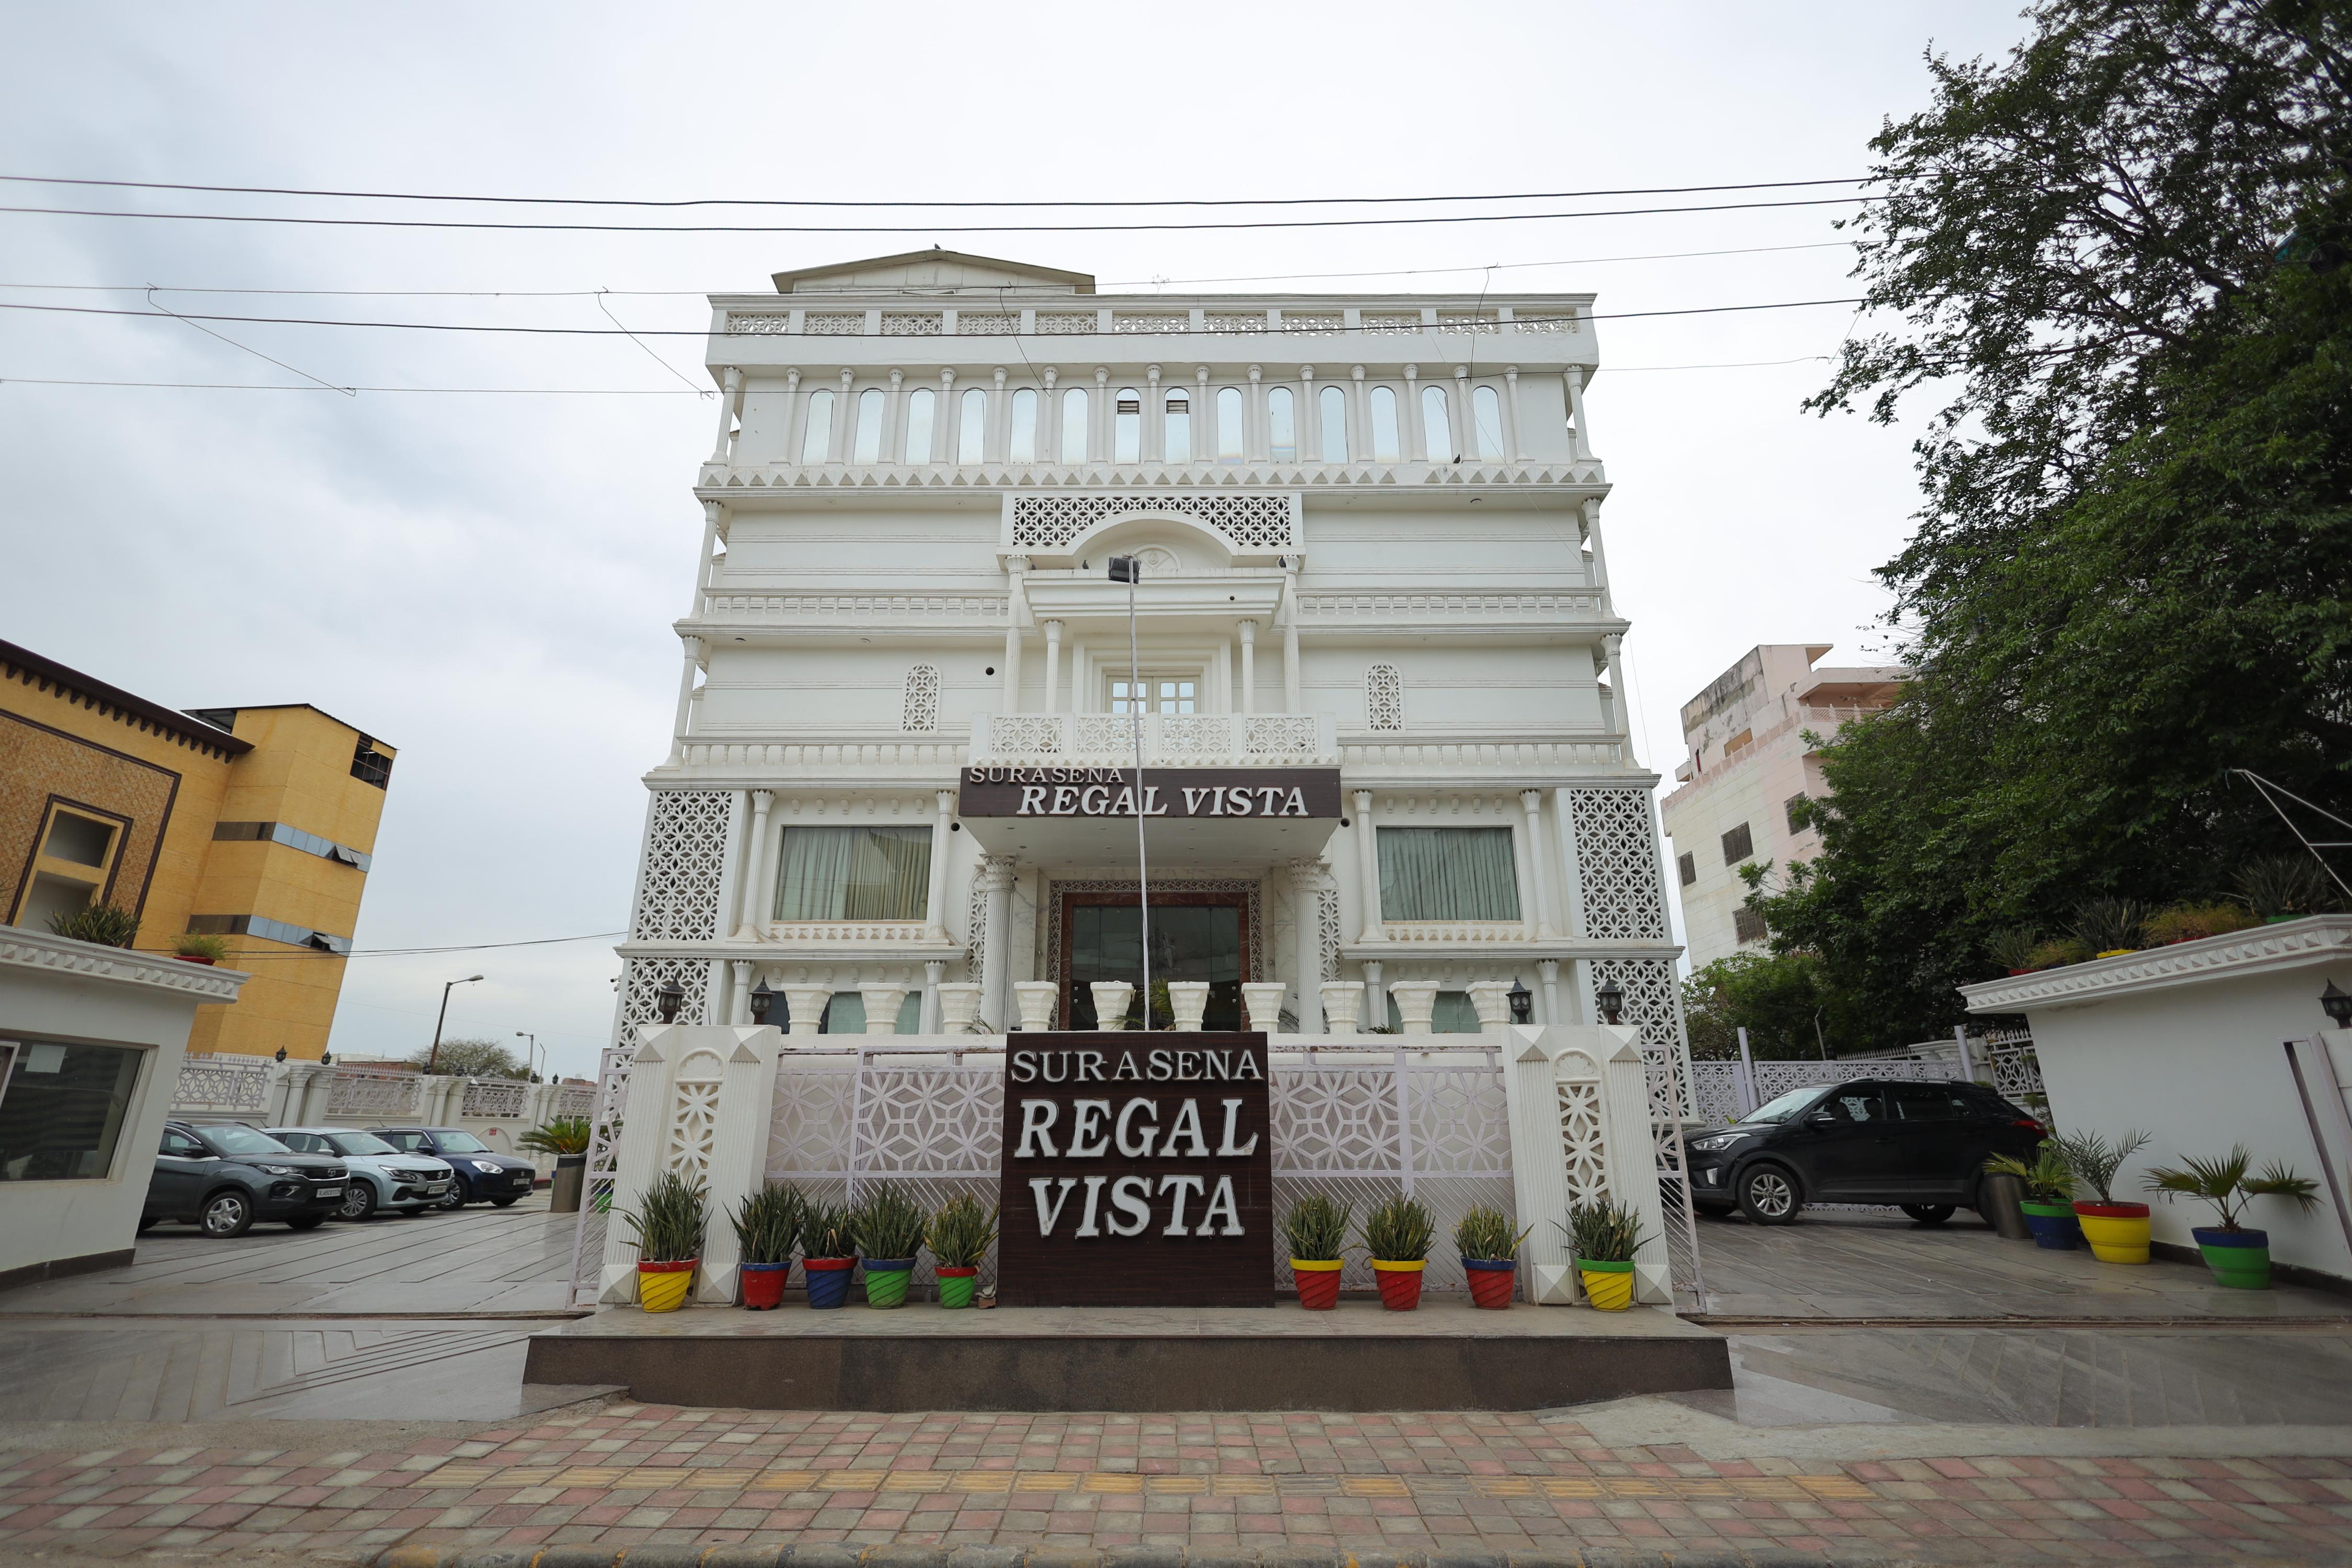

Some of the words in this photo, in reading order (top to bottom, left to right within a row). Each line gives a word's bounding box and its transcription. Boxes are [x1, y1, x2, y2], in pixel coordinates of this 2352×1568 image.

[969, 767, 1125, 783] SURASENA
[1016, 785, 1168, 815] REGAL
[1181, 786, 1309, 816] VISTA
[1010, 1050, 1264, 1082] SURASENA
[1014, 1097, 1259, 1158] REGAL
[1028, 1175, 1246, 1239] VISTA
